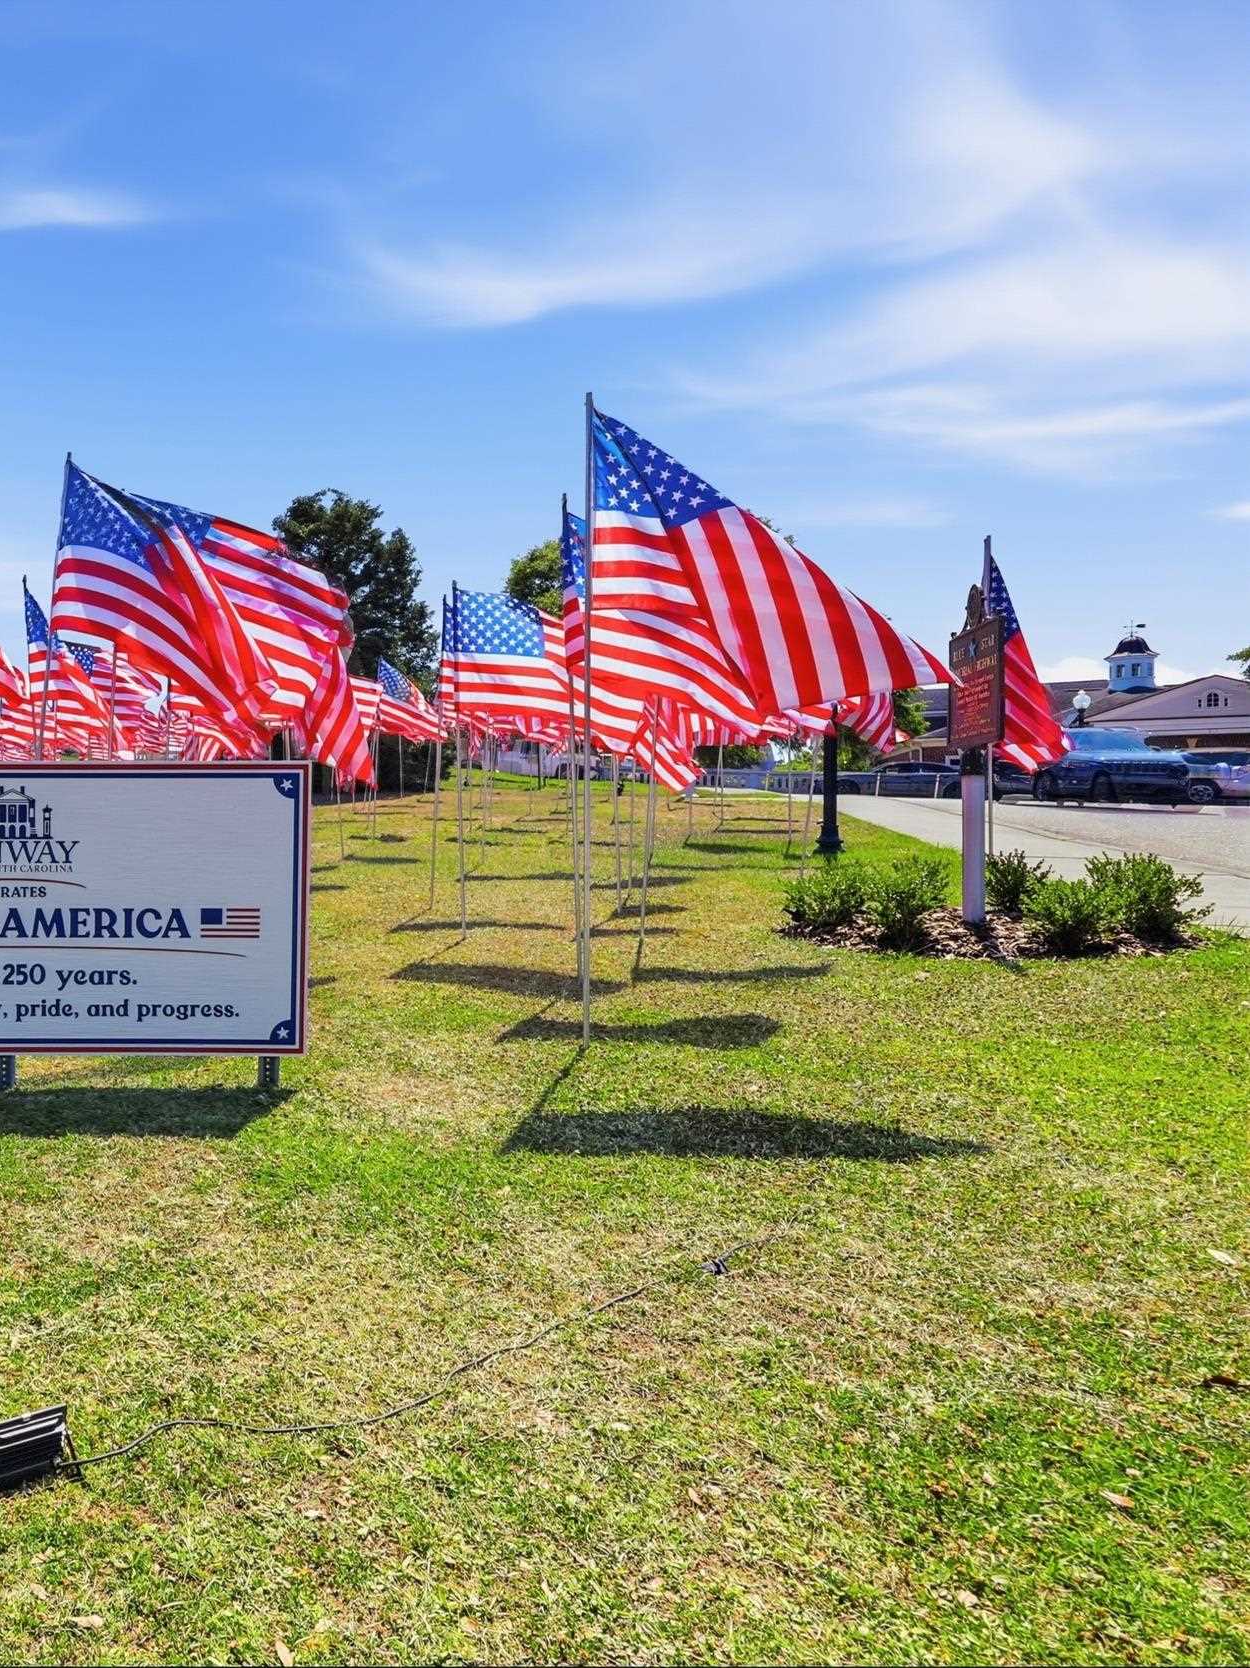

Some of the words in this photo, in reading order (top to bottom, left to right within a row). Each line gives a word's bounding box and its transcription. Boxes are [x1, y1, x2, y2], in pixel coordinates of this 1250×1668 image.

[19, 864, 73, 873] CAROLINA
[0, 908, 191, 938] AMERICA
[2, 963, 46, 985] 250
[56, 970, 137, 991] years.
[15, 999, 79, 1022] pride,
[87, 999, 129, 1017] and
[137, 1004, 239, 1022] progress.
